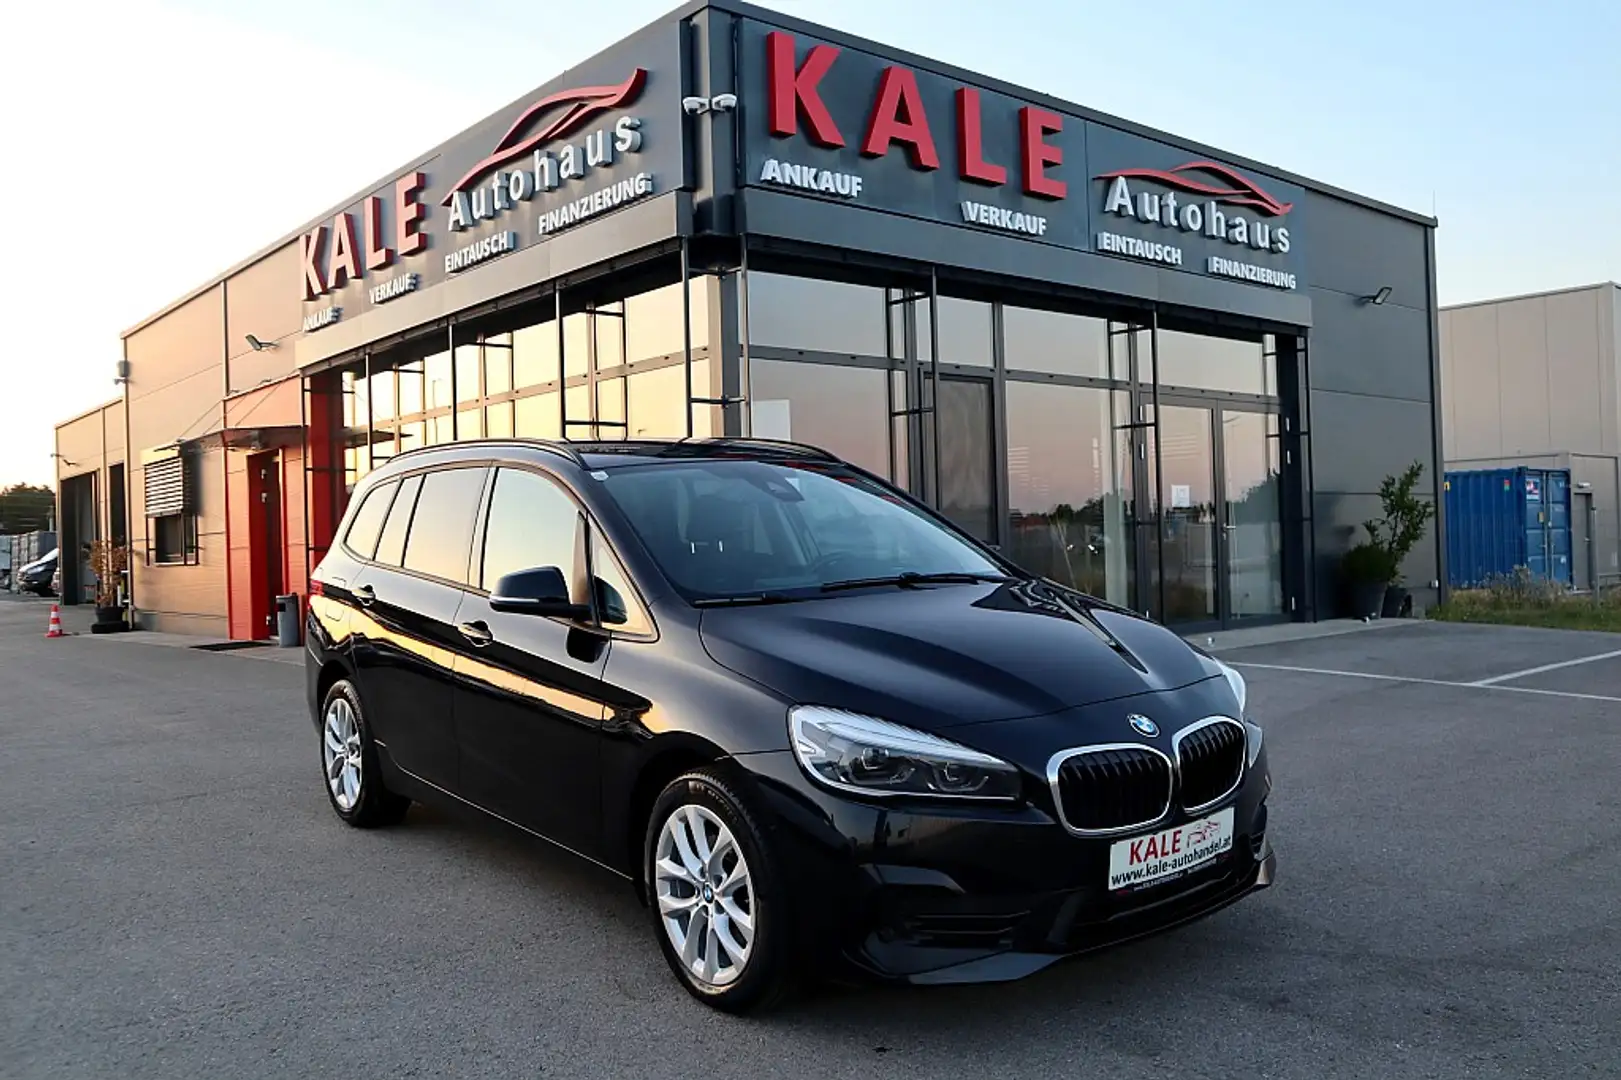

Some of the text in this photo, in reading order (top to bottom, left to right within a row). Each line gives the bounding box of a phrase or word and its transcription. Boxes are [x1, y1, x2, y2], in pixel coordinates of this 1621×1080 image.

[448, 116, 642, 231] Autohaus
[767, 32, 1067, 200] KALE
[301, 172, 426, 300] KALE
[369, 273, 418, 304] VERKAUF
[444, 231, 515, 273] EINTAUSCH
[538, 172, 653, 235] FINANZIERUNG
[760, 158, 1297, 290] ANKAUF VERKAUF EINTAUSCH FINANZIERUNG
[1104, 176, 1291, 254] Autohaus
[1111, 836, 1232, 886] www.kale-autohandel.at
[1129, 829, 1182, 866] KALE
